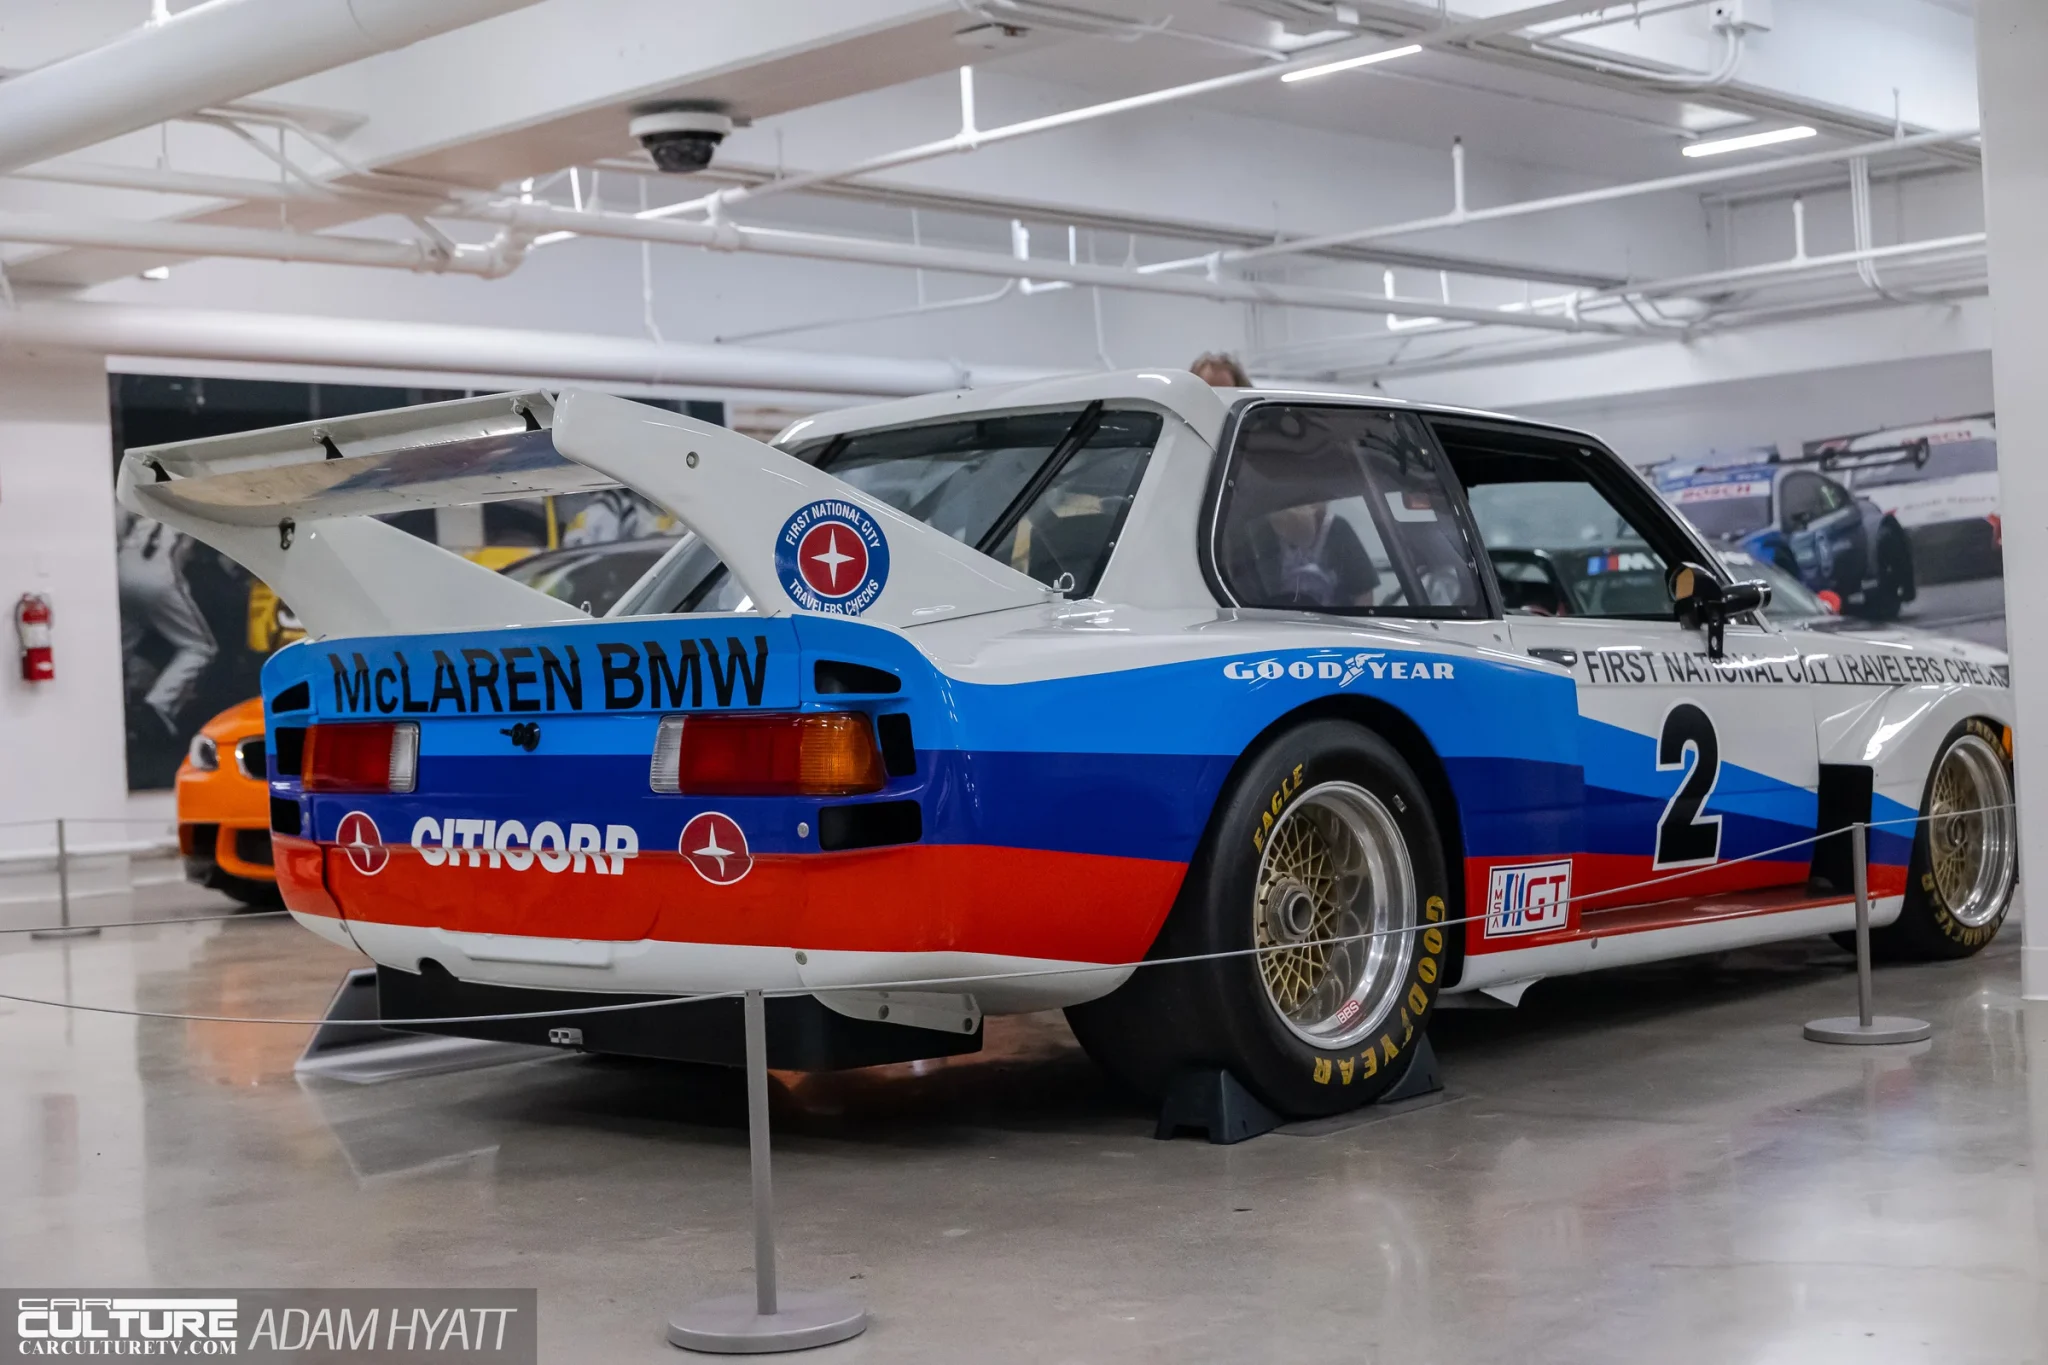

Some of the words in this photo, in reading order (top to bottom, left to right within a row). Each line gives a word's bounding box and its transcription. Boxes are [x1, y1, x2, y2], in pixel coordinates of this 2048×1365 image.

[786, 510, 811, 546] FIRST
[811, 502, 860, 526] NATIONAL
[861, 520, 881, 548] CITY
[789, 578, 844, 615] TRAVELERS
[845, 578, 880, 616] CHECKS
[328, 644, 583, 714] McLAREN
[597, 635, 769, 710] BMW
[1582, 651, 1658, 683] FIRST
[1834, 654, 1945, 684] TRAVELERS
[1655, 701, 1720, 867] 2
[1253, 764, 1303, 854] EAGLE
[412, 816, 639, 875] CITICORP
[1525, 874, 1567, 922] GT
[1337, 1001, 1360, 1024] BBS
